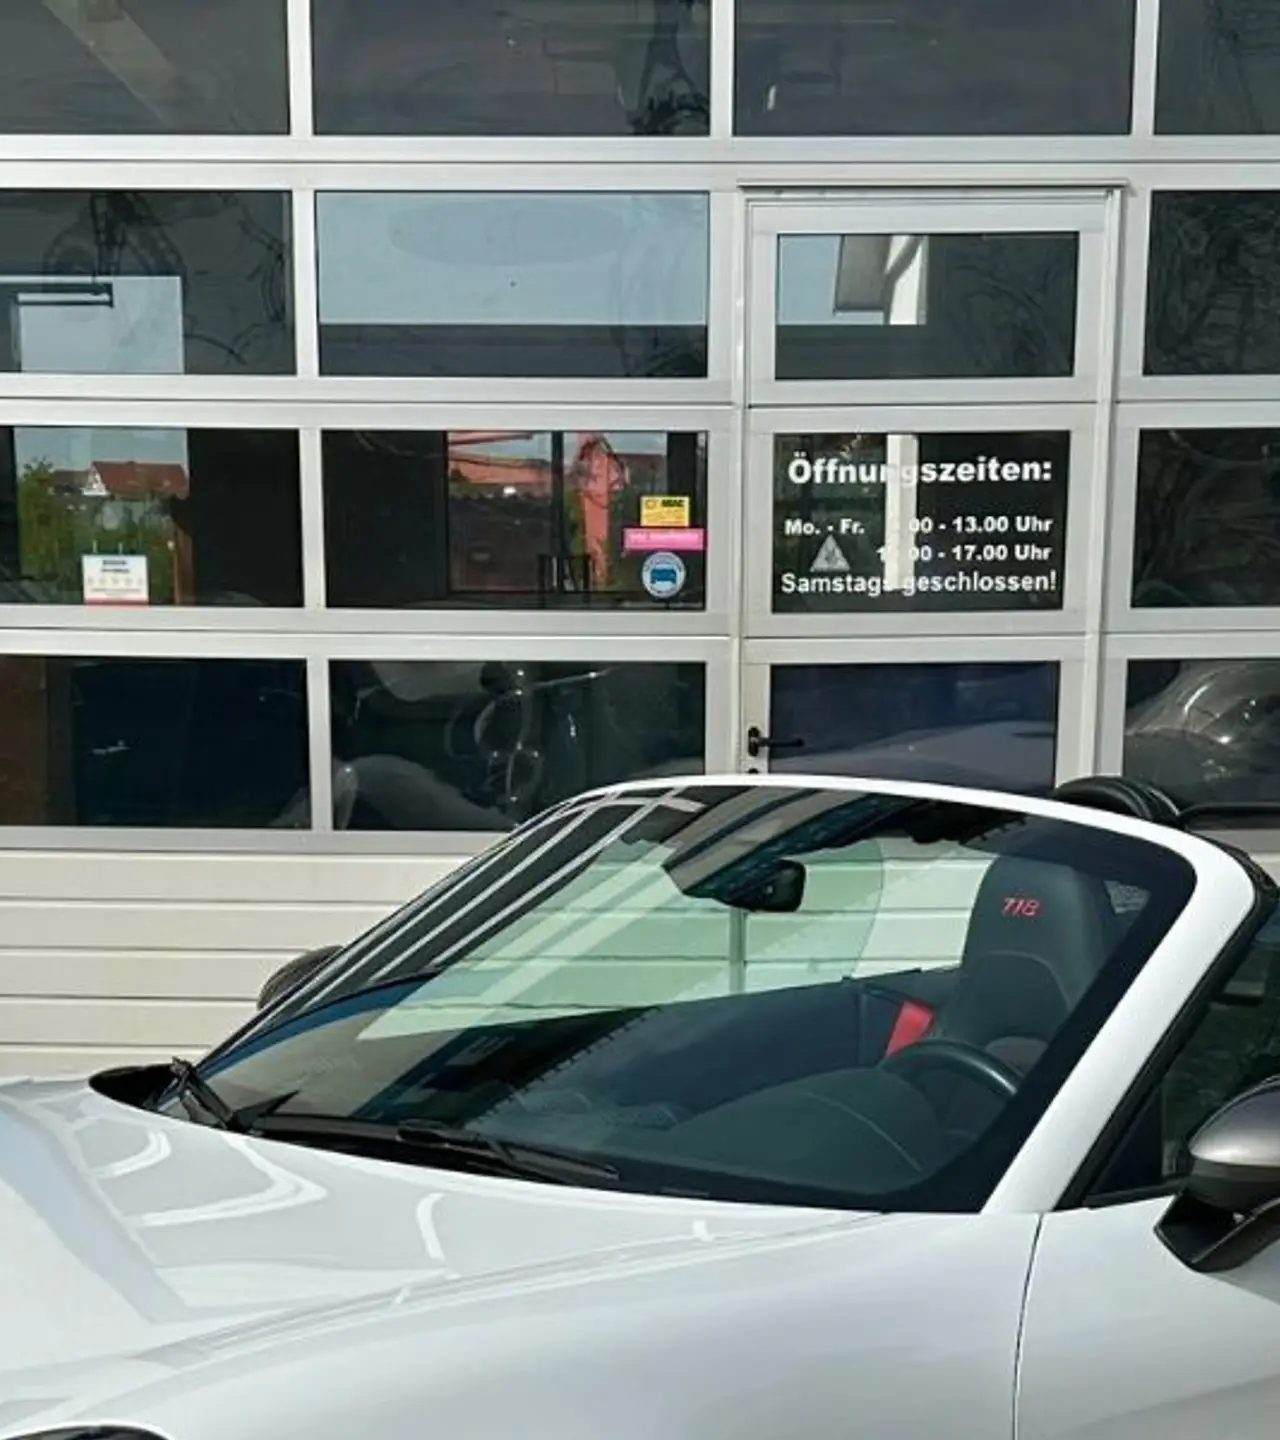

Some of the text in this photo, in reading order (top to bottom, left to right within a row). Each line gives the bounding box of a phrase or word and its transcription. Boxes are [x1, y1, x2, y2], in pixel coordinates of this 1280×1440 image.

[788, 452, 1053, 484] Öffnungszeiten:
[784, 519, 821, 535] Mo.
[839, 519, 866, 534] Fr.
[952, 517, 1010, 533] 13.00
[1016, 516, 1054, 533] Uhr
[952, 545, 1008, 560] 17.00
[1015, 545, 1054, 560] Uhr
[781, 570, 1058, 597] Samstags geschlossen!
[1003, 898, 1040, 917] 718
